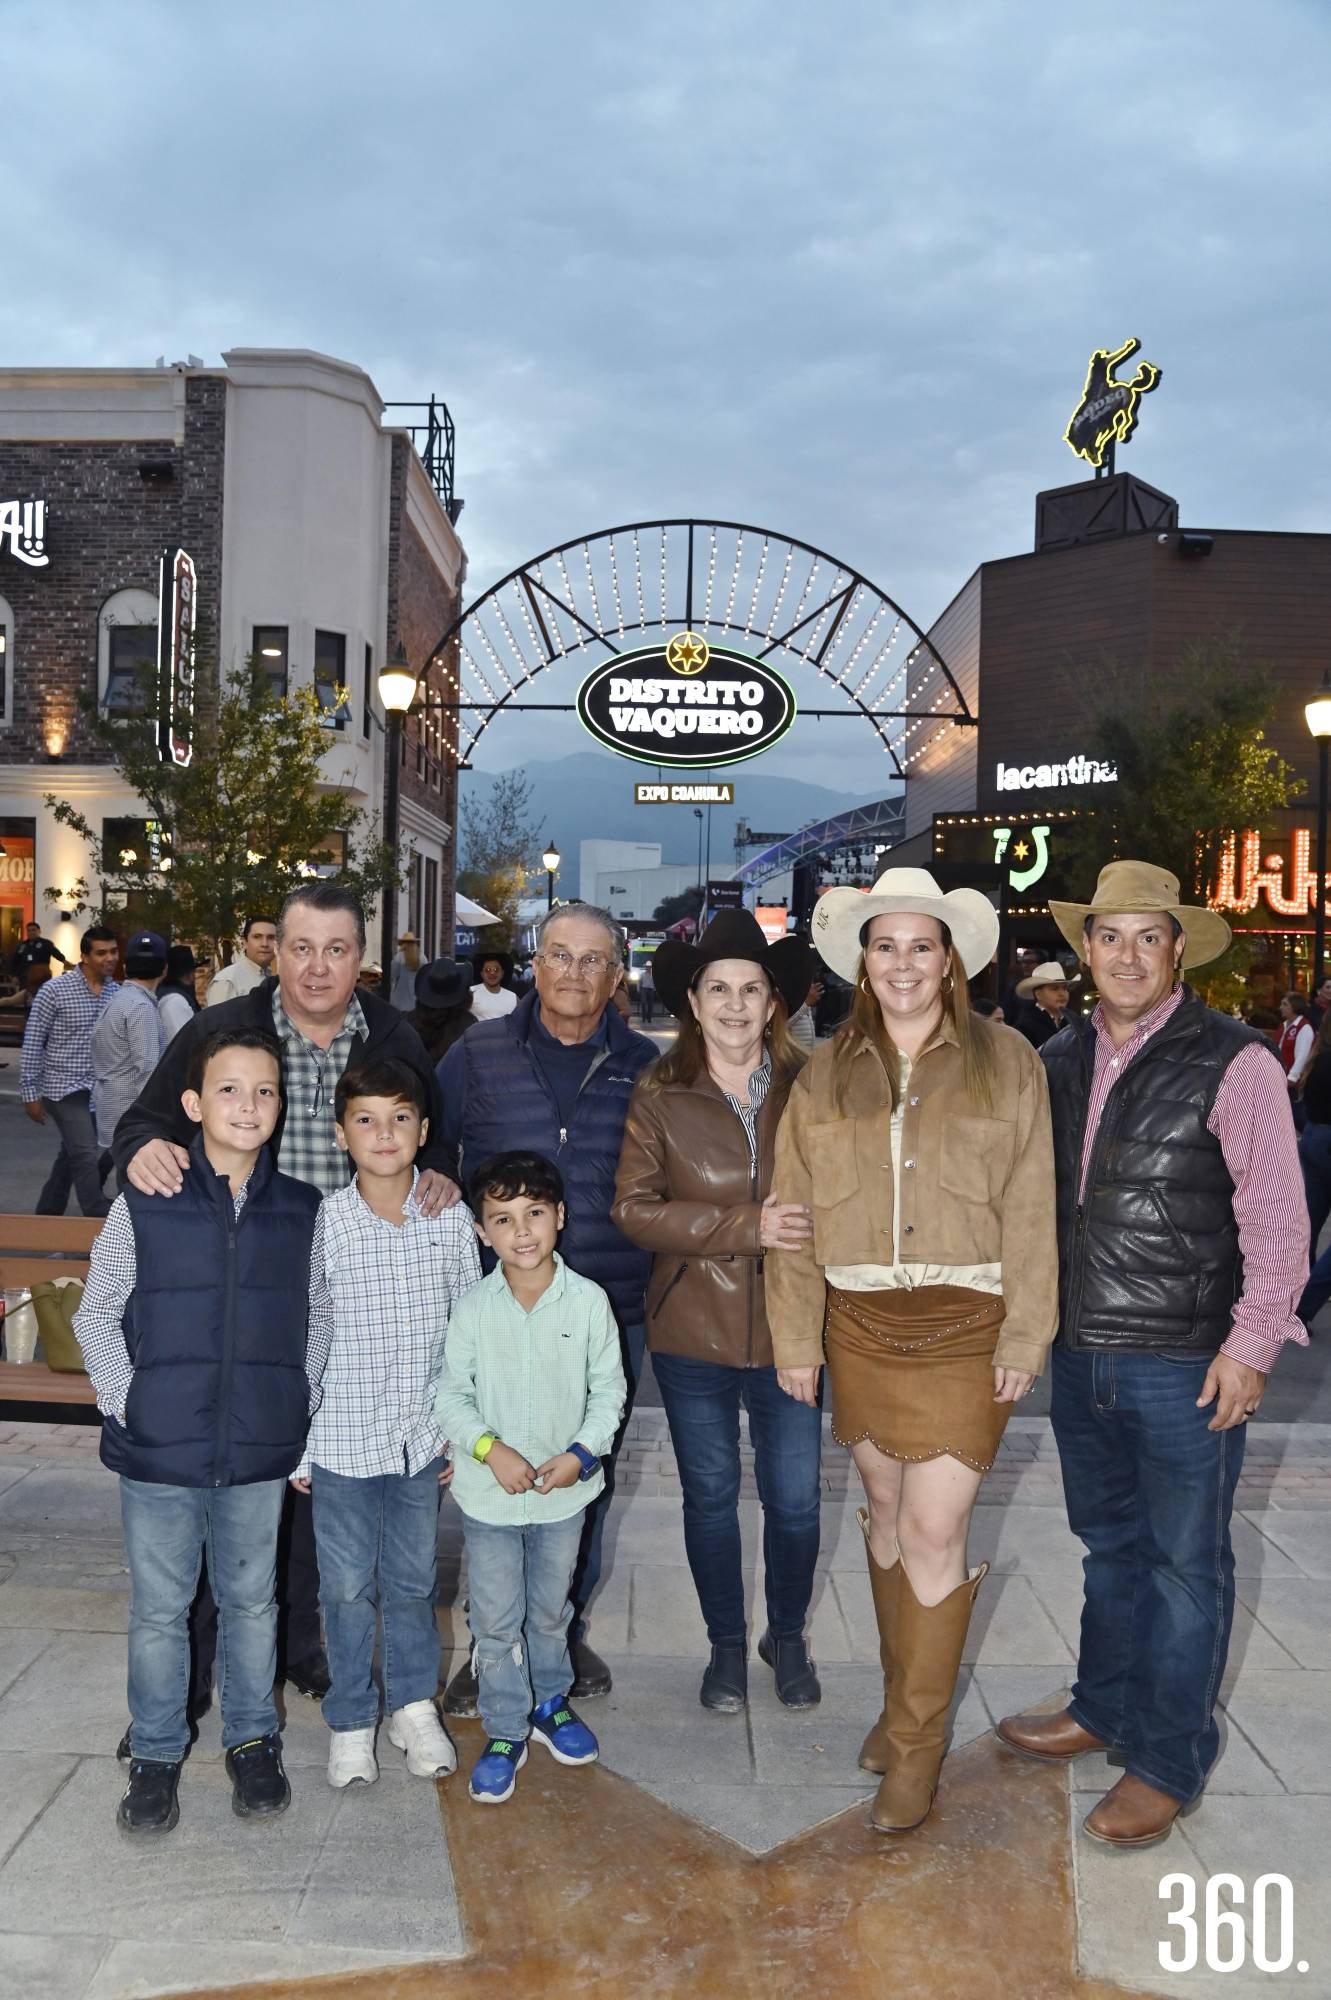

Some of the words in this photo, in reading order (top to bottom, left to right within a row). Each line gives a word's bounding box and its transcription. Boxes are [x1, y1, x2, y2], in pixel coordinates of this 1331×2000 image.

[609, 678, 764, 706] DISTRITO
[609, 707, 764, 738] VAQUERO
[637, 785, 669, 801] EXPO
[671, 786, 731, 801] COAHUILA
[554, 1711, 572, 1726] NIKE
[490, 1741, 513, 1755] NIKE
